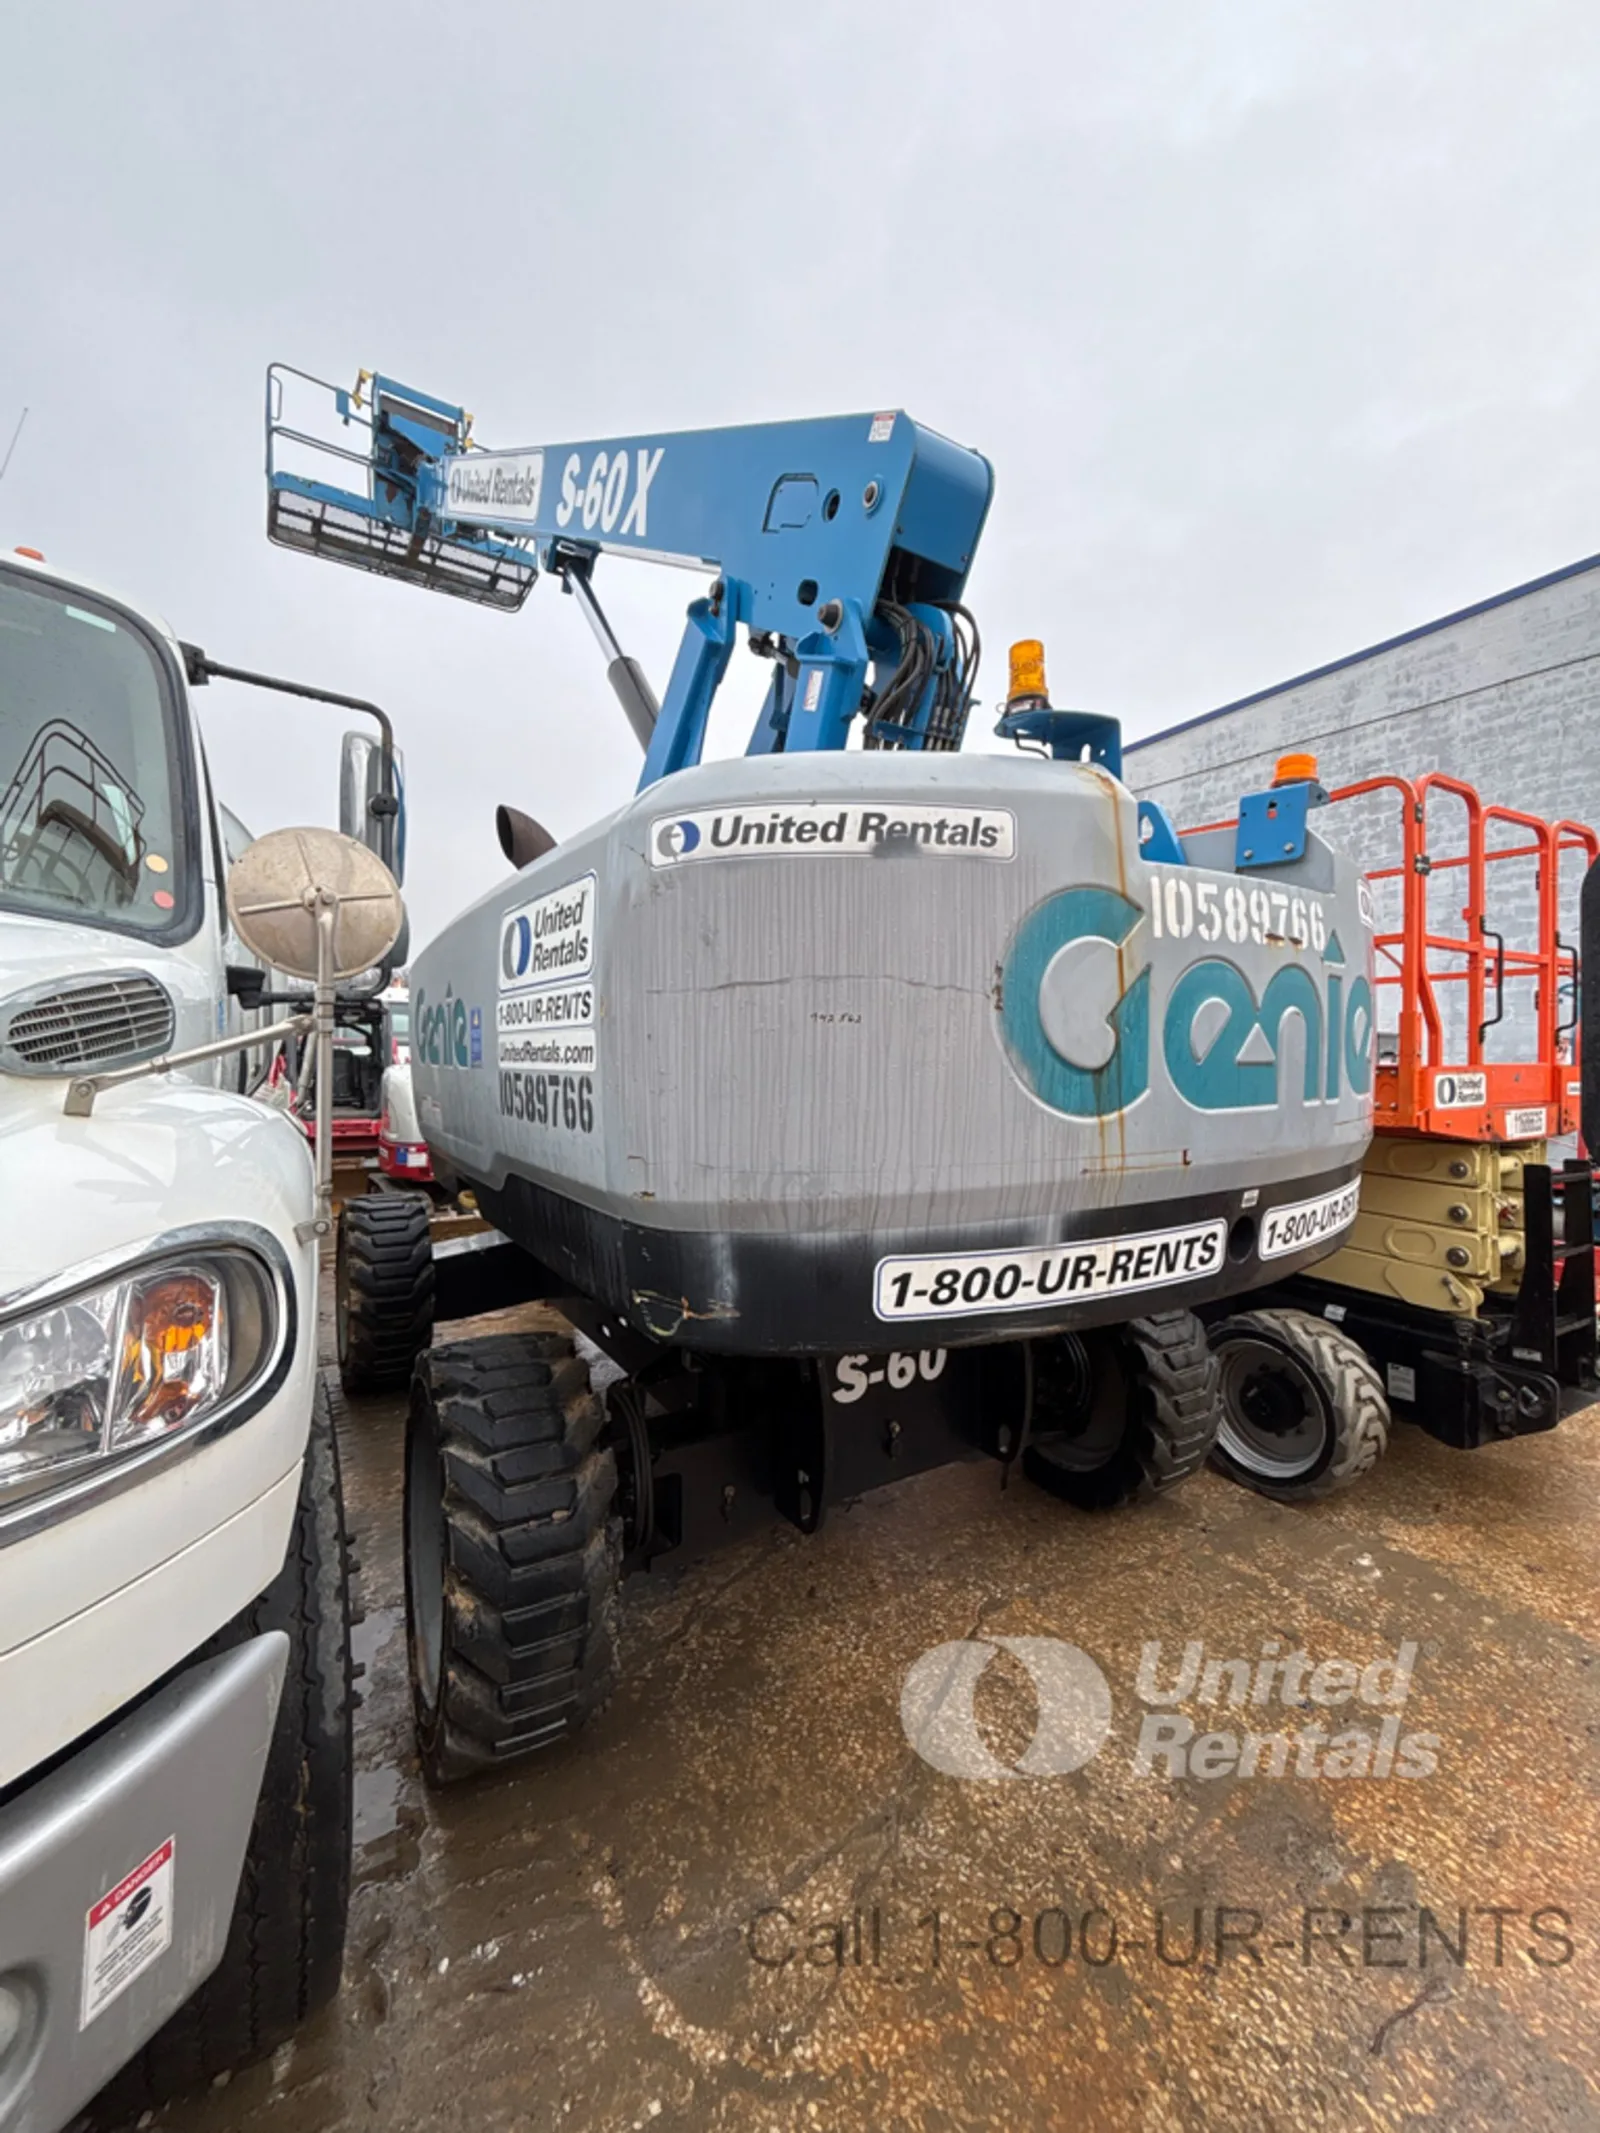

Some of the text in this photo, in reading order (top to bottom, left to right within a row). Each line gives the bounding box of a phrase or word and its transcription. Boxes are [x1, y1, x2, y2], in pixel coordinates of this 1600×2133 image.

[710, 802, 1000, 849] United Rentals
[533, 891, 586, 940] United
[1151, 876, 1326, 951] 10589766
[531, 929, 589, 974] Rentals
[415, 980, 469, 1068] Genie
[499, 991, 592, 1027] 1-800-UR-RENTS
[998, 884, 1373, 1118] Genie
[500, 1038, 594, 1065] UnitedRentals.com
[500, 1074, 594, 1134] 10589766
[888, 1231, 1219, 1308] 1-800-UR-RENTS
[832, 1347, 948, 1405] S-60
